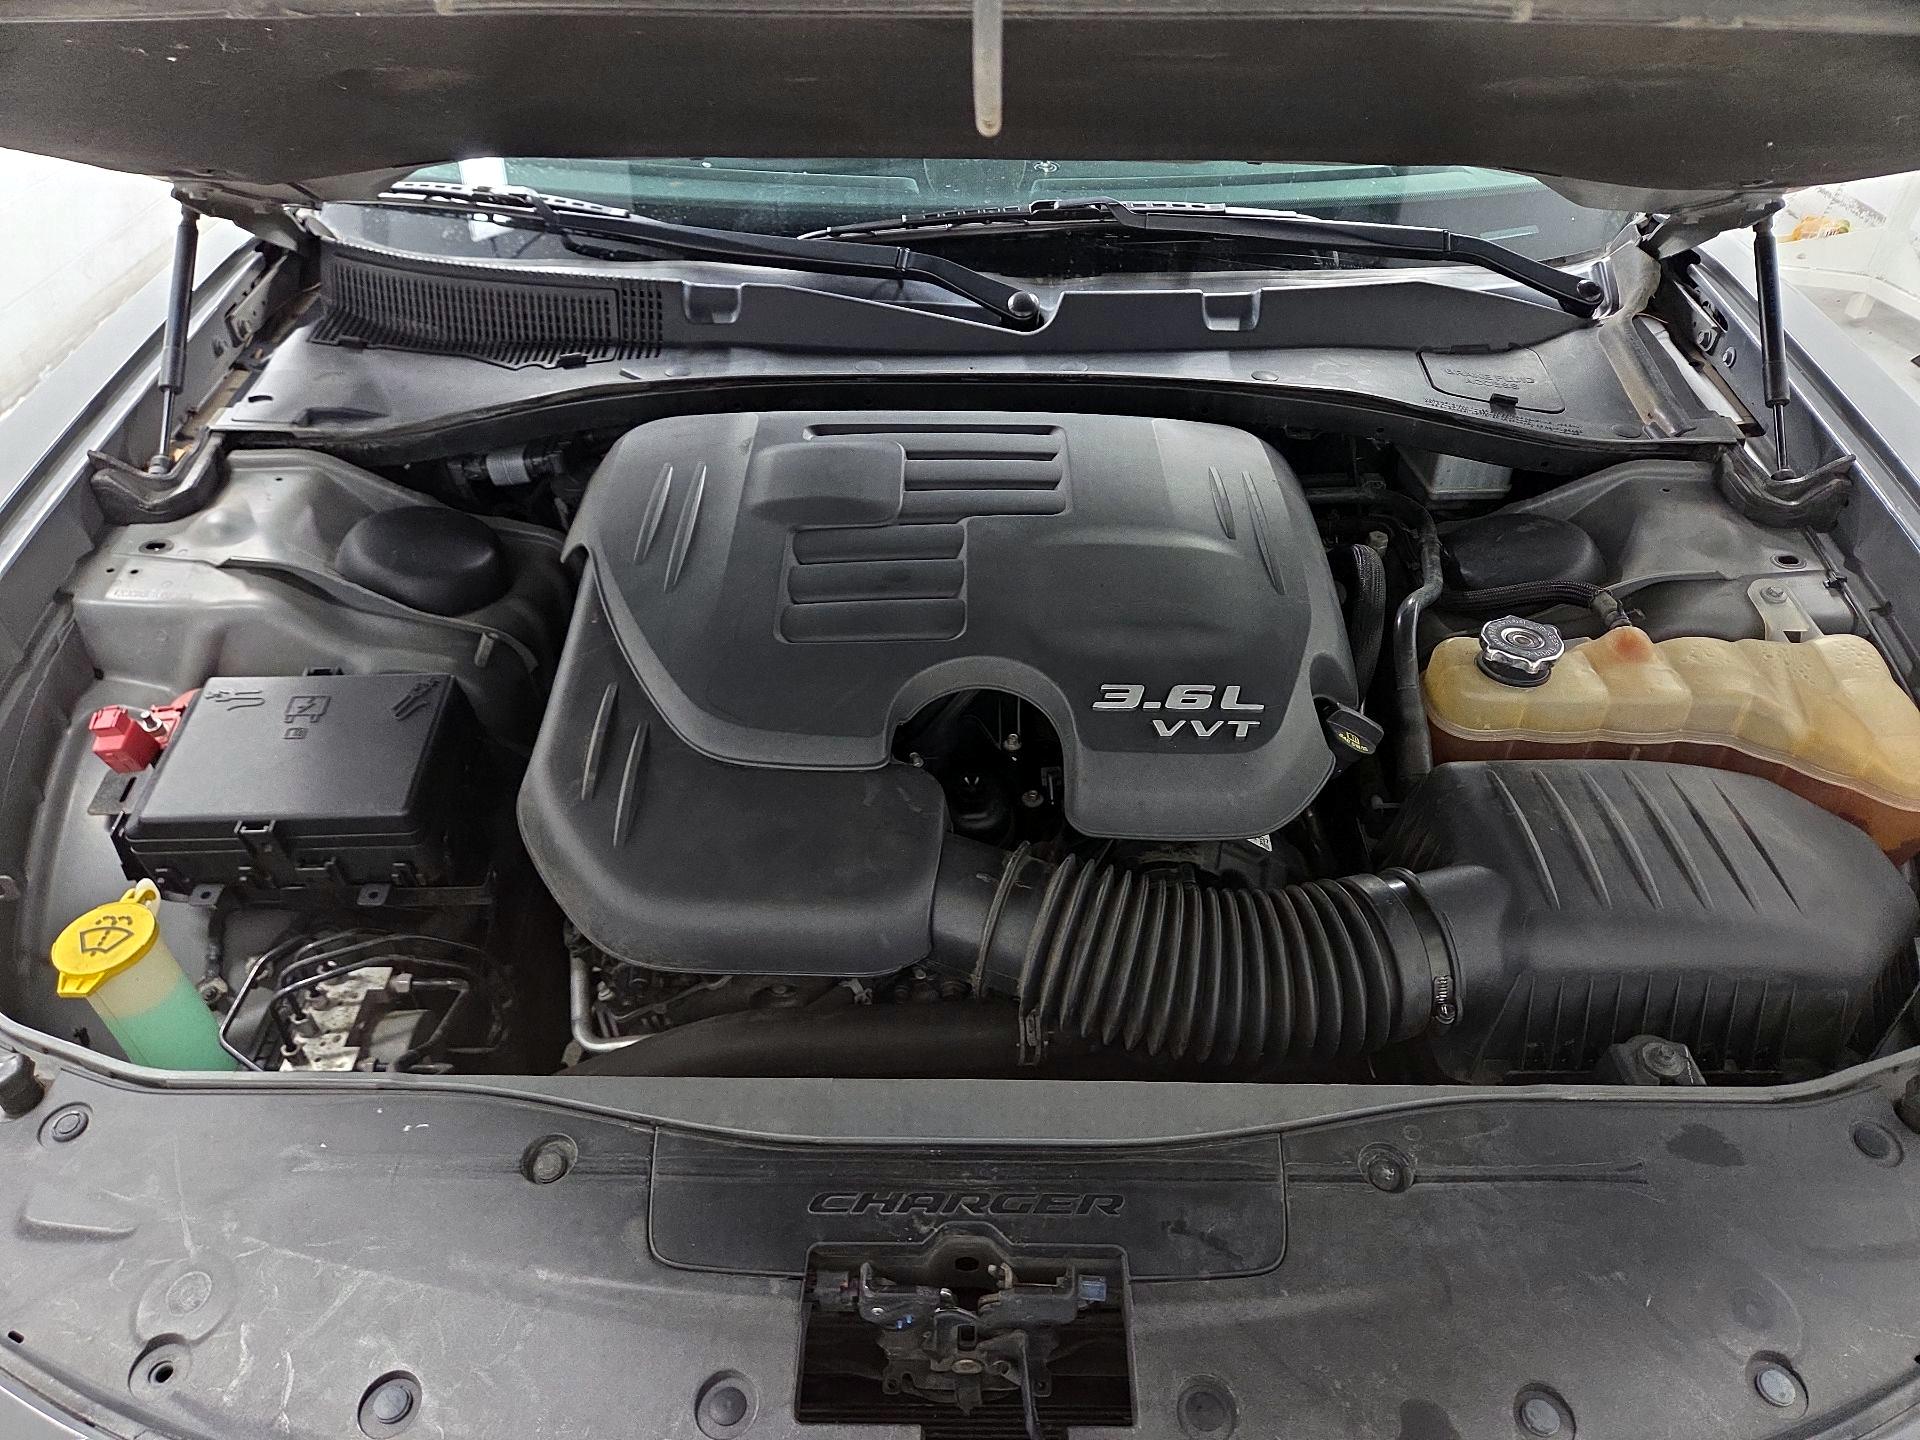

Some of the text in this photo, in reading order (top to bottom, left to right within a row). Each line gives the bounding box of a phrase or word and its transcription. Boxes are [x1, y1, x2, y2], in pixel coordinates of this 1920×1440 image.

[1092, 684, 1265, 710] 3.6L
[1152, 719, 1261, 737] VVT
[807, 1193, 1125, 1216] CHARGER
